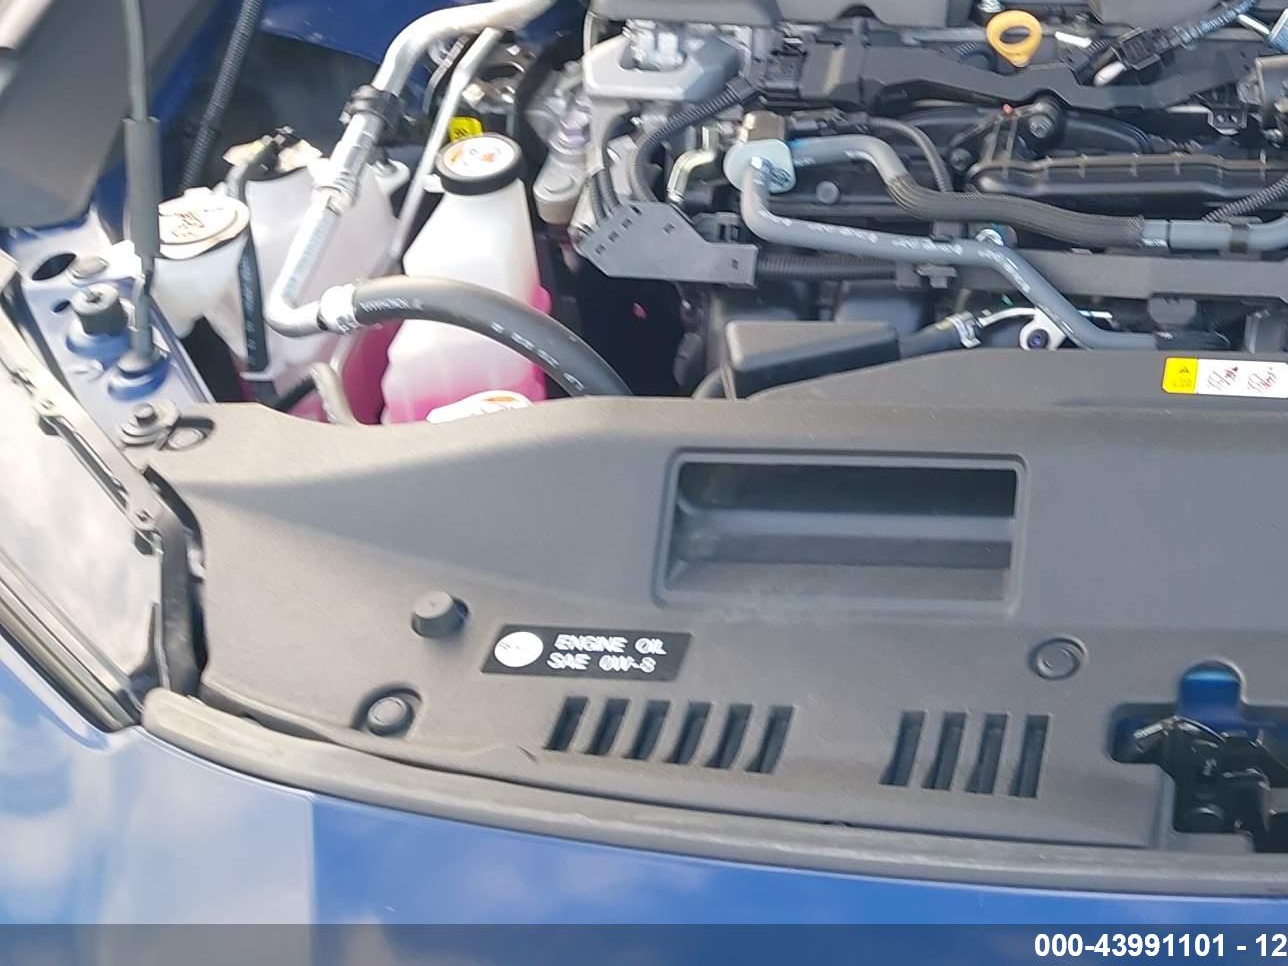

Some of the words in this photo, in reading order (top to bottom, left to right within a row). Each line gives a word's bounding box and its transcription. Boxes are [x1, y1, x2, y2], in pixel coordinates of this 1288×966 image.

[554, 634, 628, 653] ENGINE
[634, 637, 667, 655] OIL
[546, 652, 592, 670] SAE
